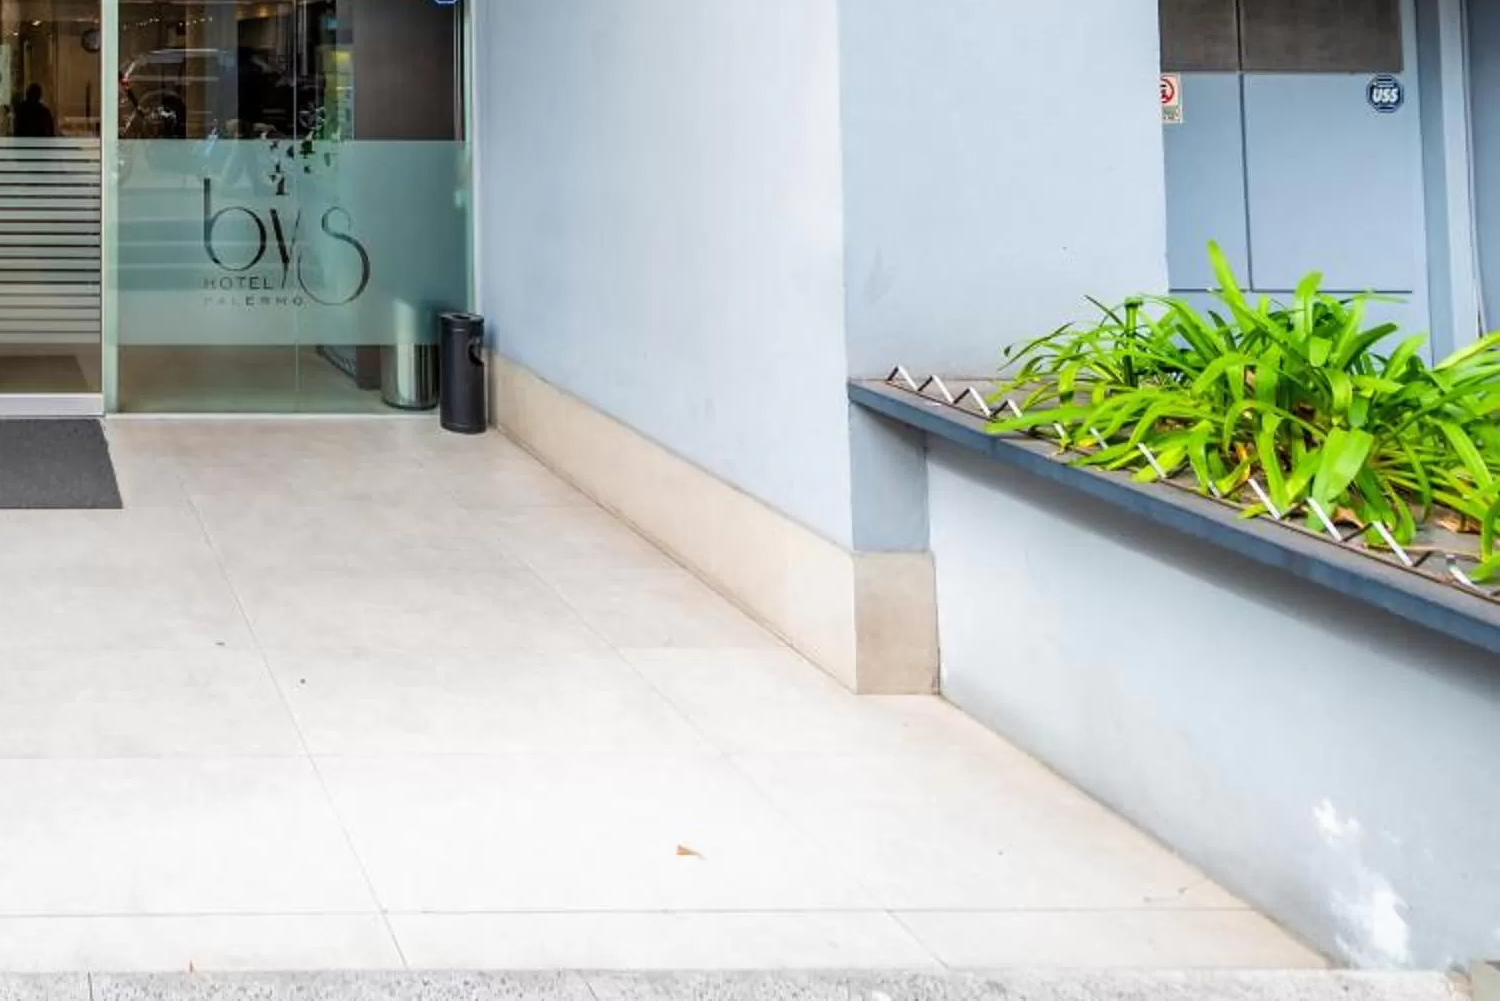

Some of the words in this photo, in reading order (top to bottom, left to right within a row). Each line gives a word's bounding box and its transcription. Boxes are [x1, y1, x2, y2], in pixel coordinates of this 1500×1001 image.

[1372, 88, 1399, 103] USS
[203, 177, 370, 305] bys
[202, 276, 273, 290] HOTEL
